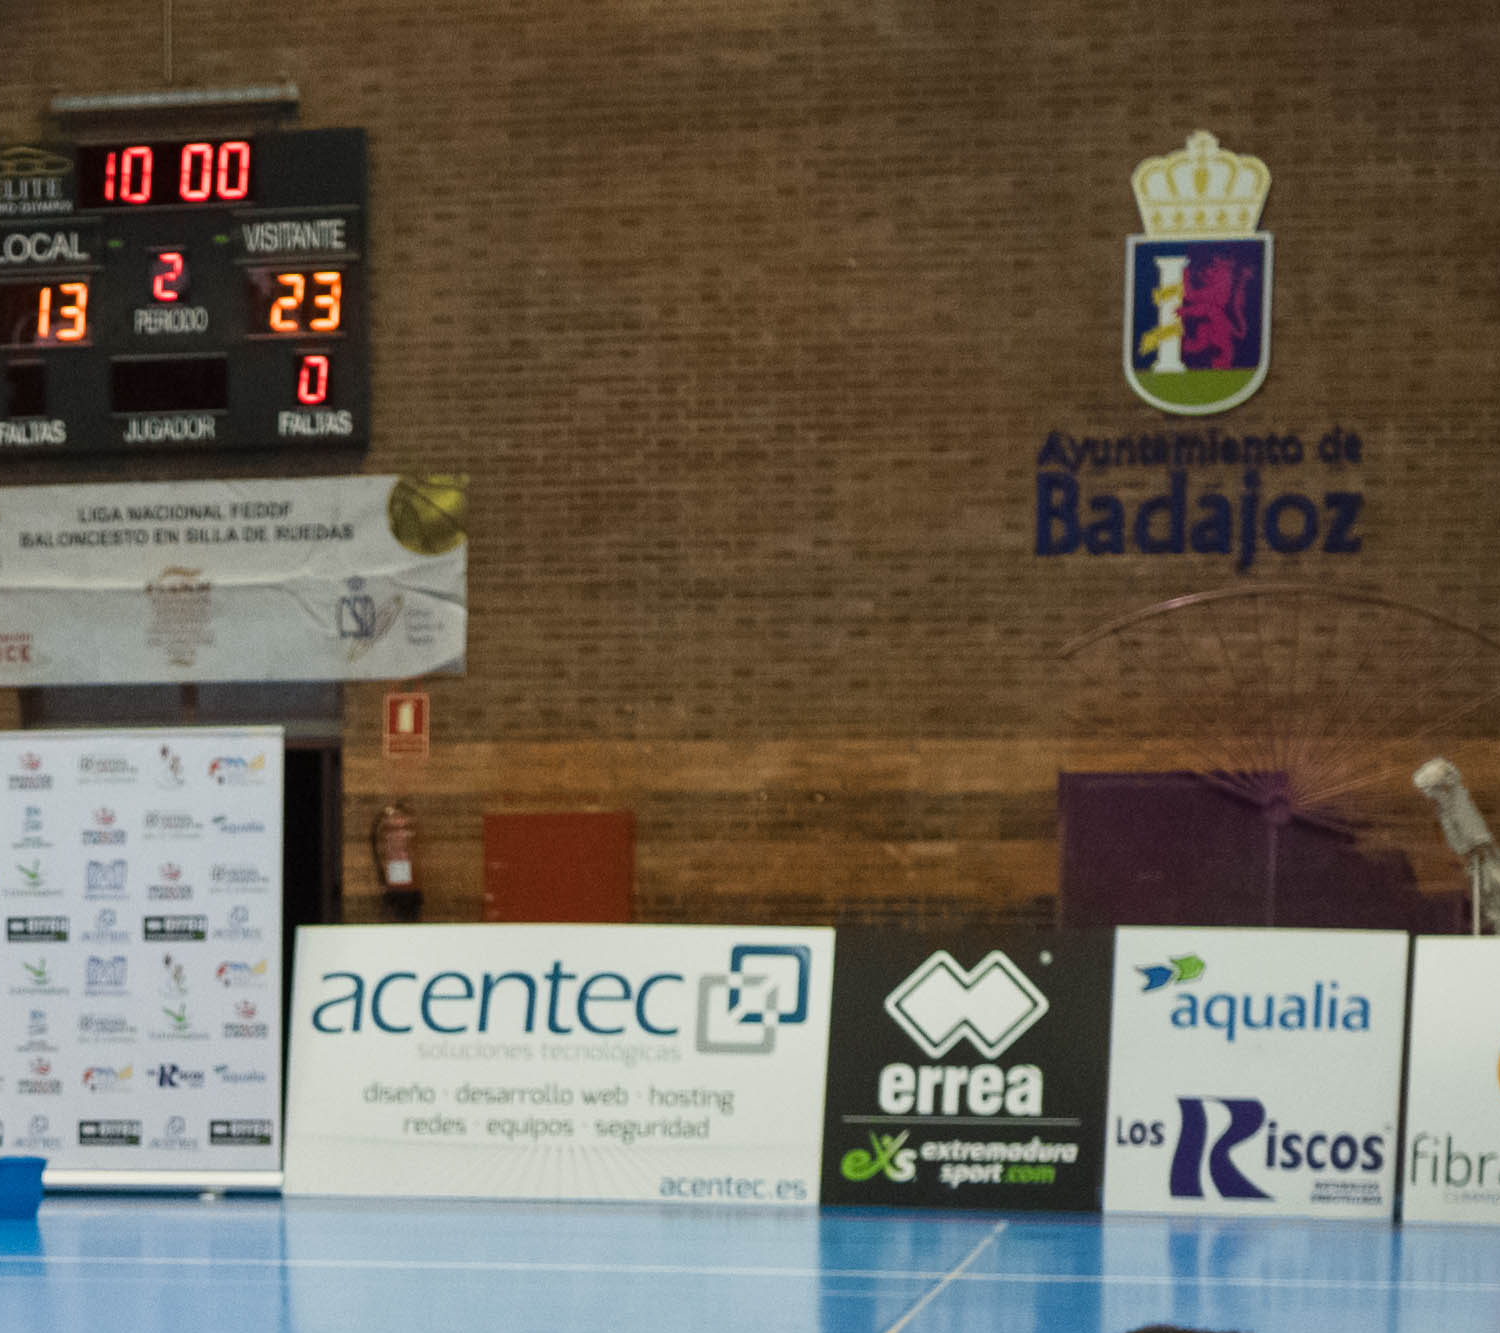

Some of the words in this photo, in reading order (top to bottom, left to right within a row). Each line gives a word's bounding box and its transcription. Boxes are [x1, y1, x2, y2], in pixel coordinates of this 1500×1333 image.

[105, 145, 153, 204] 10
[180, 141, 250, 202] 00
[242, 219, 346, 251] VISITANTE
[153, 252, 184, 302] 2
[37, 282, 88, 341] 13
[269, 271, 342, 332] 23
[134, 307, 209, 334] PERIODO
[297, 355, 329, 405] 0
[123, 415, 216, 442] JUGADOR
[277, 410, 353, 437] FALTAS
[1037, 430, 1304, 474] Ayuntamiento
[1318, 427, 1362, 464] de
[78, 506, 123, 523] LIGA
[129, 501, 223, 521] NACIONAL
[1035, 469, 1365, 575] Badajoz
[19, 529, 148, 548] BALONCESTO
[153, 528, 179, 545] EN
[187, 526, 243, 544] SILLA
[244, 525, 267, 543] DE
[275, 524, 354, 542] RUEDAS
[311, 960, 684, 1036] acentec
[1170, 982, 1372, 1043] aqualia
[417, 1039, 533, 1062] soluciones
[540, 1038, 682, 1068] tecnológicas
[363, 1081, 437, 1105] diseño
[455, 1081, 574, 1105] desarrollo
[581, 1083, 629, 1106] web
[648, 1086, 735, 1114] hosting
[878, 1062, 1043, 1116] errea
[403, 1113, 466, 1136] redes
[486, 1113, 575, 1141] equipos
[592, 1117, 710, 1143] seguridad
[919, 1137, 1079, 1164] extremadura
[1169, 1097, 1385, 1200] Riscos
[659, 1175, 807, 1201] acentec.es
[939, 1164, 1056, 1189] sport.com
